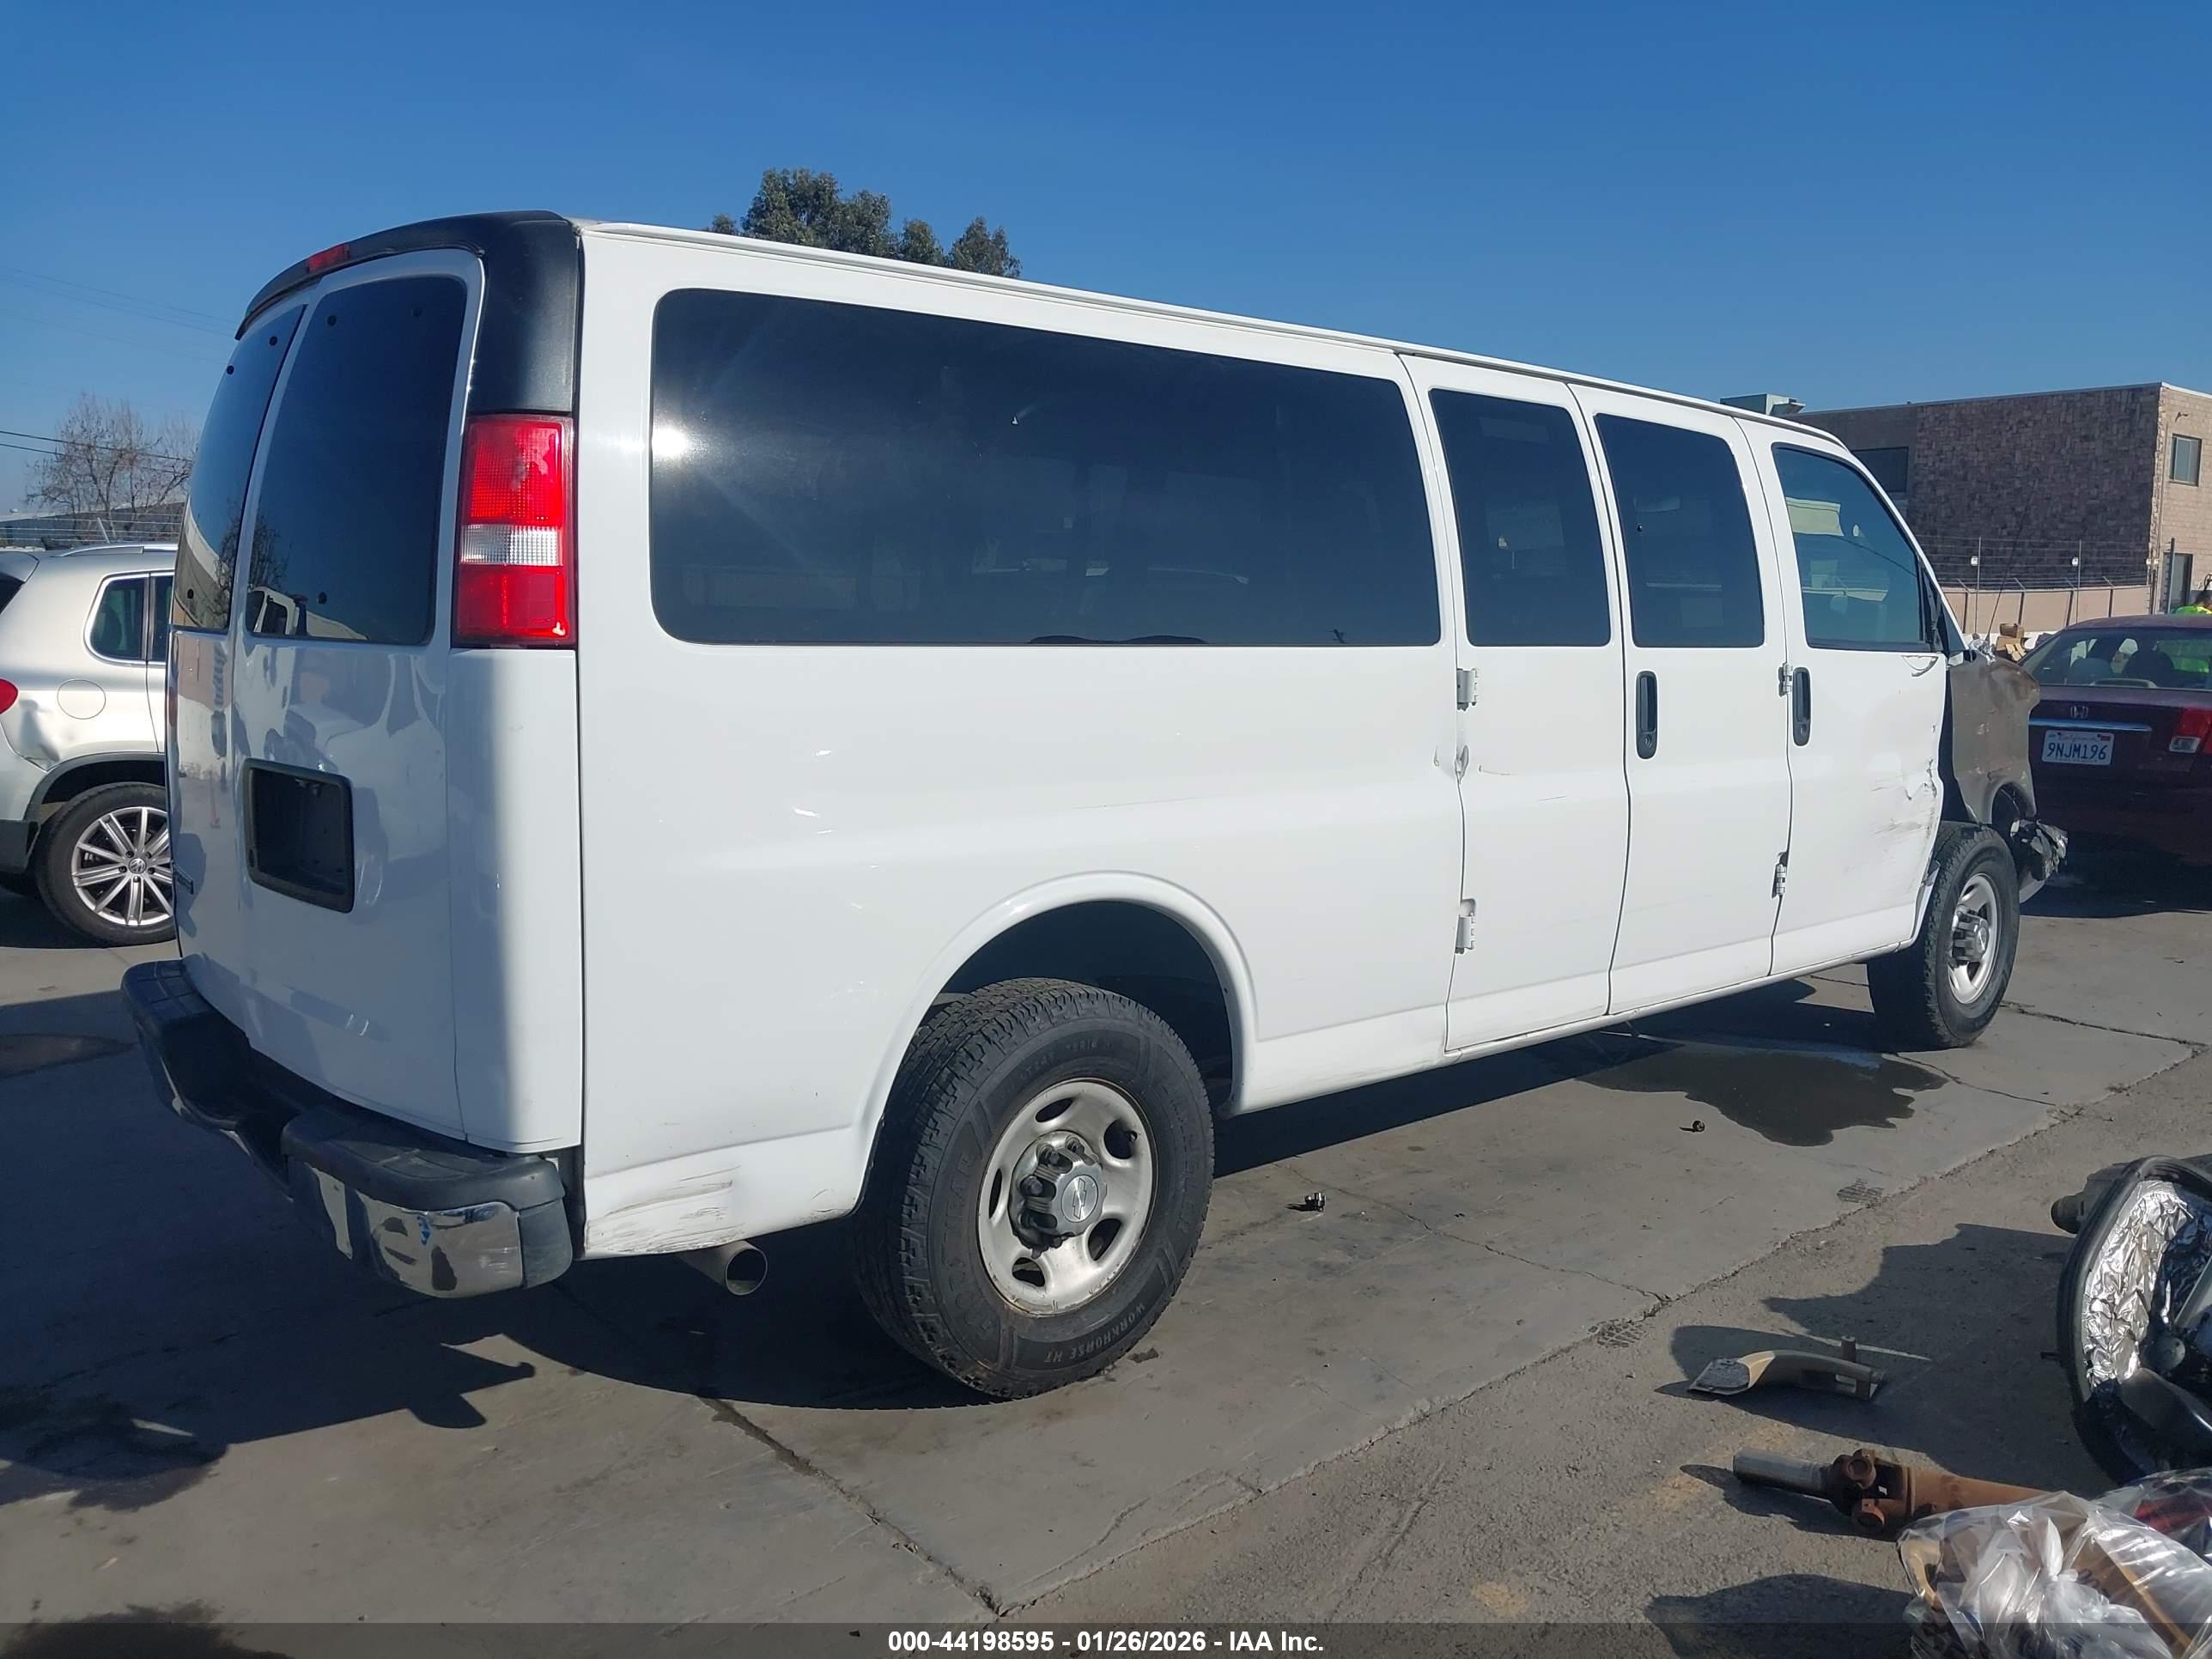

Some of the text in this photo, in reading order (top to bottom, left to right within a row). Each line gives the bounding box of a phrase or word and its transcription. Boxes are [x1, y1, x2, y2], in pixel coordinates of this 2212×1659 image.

[2046, 742, 2108, 760] 9NJM196
[1043, 1302, 1146, 1363] WORKHORSE HT
